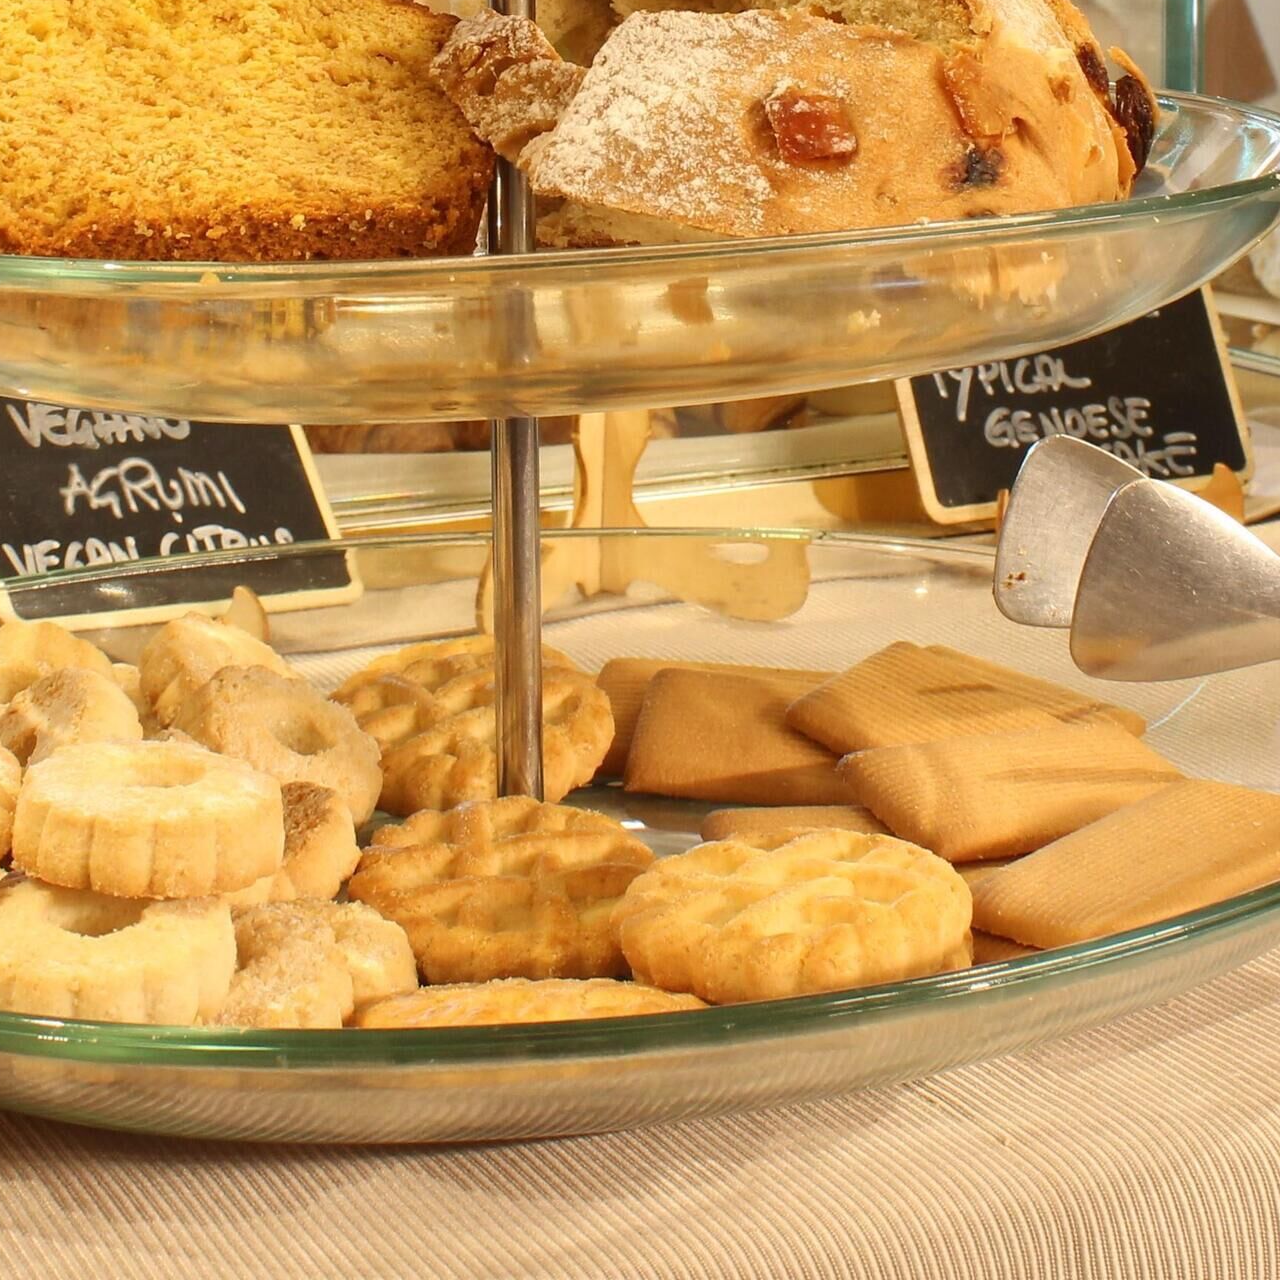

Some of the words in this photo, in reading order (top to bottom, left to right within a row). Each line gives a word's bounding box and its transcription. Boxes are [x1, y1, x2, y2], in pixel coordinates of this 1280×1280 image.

[984, 396, 1154, 448] GENOESE
[1101, 431, 1197, 476] AKE
[59, 456, 247, 523] AGRUMI
[1, 535, 140, 577] VEGAN
